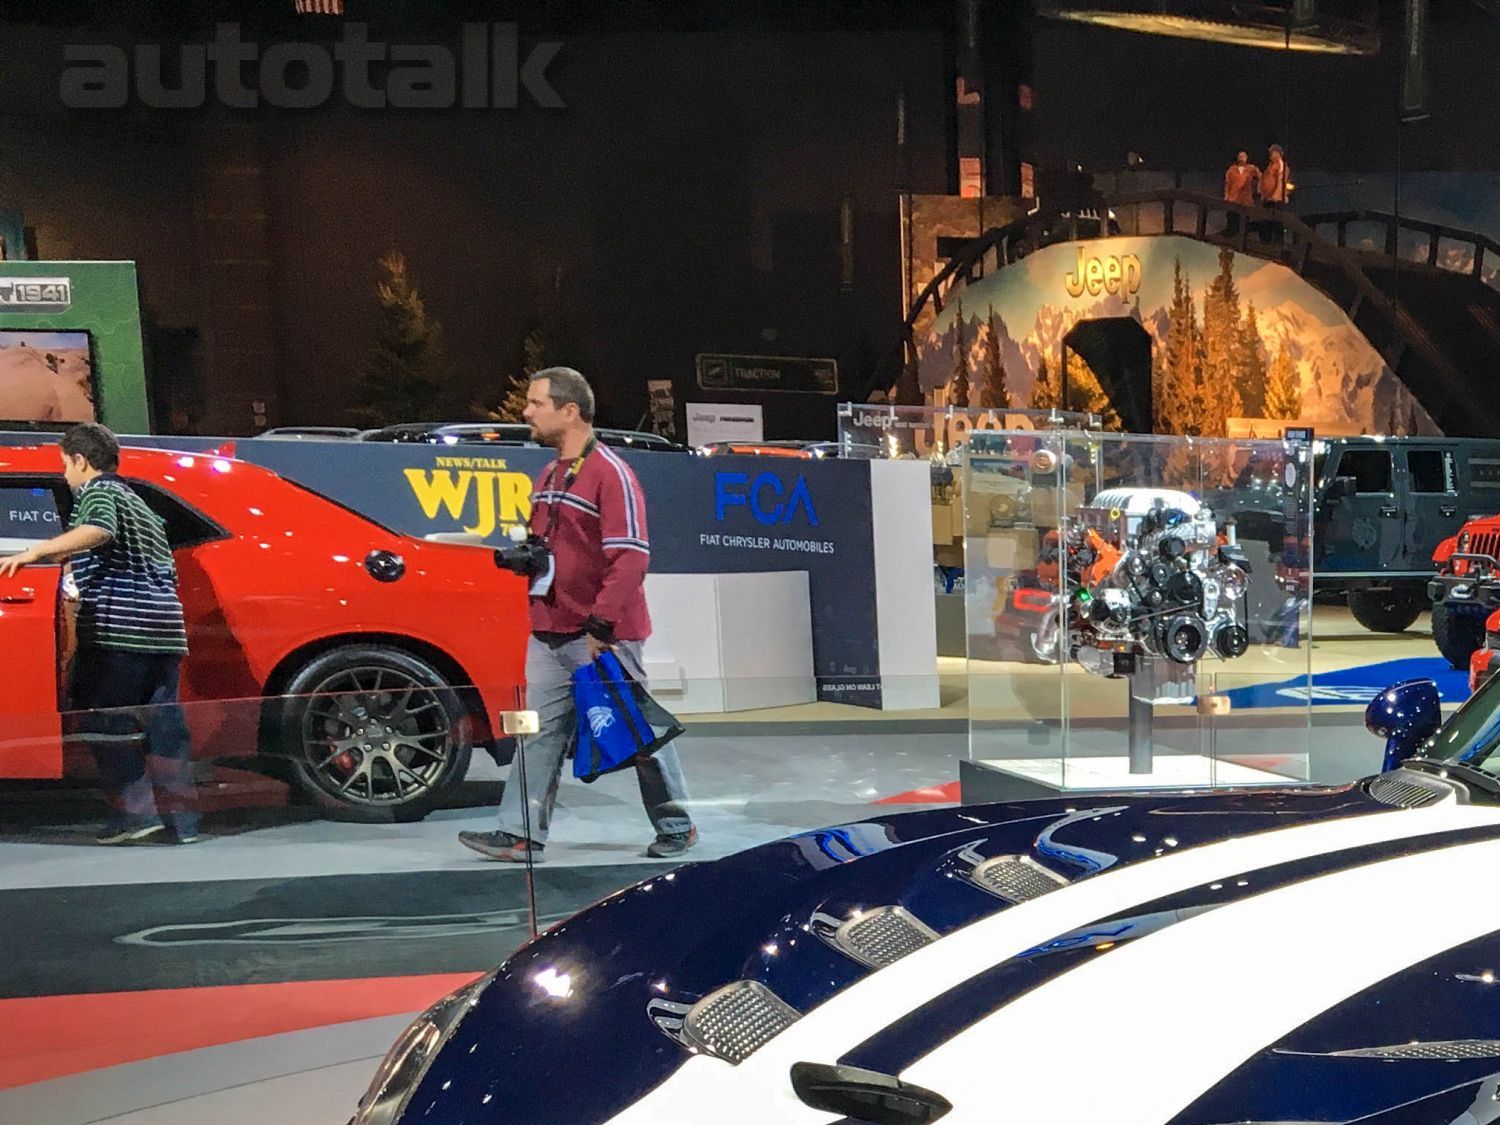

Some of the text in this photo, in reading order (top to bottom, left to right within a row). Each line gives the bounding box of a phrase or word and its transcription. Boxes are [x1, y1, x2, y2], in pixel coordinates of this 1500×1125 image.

[1065, 246, 1142, 305] Jeep
[15, 284, 68, 302] 1941
[734, 367, 781, 380] TRACTION
[853, 410, 893, 430] Jeep
[435, 456, 507, 470] NEWS/TALK
[403, 468, 533, 538] WJR
[715, 471, 819, 526] FCA
[9, 510, 39, 522] FIAT
[700, 534, 835, 554] FIAT CHRYSLER AUTOMOBILES
